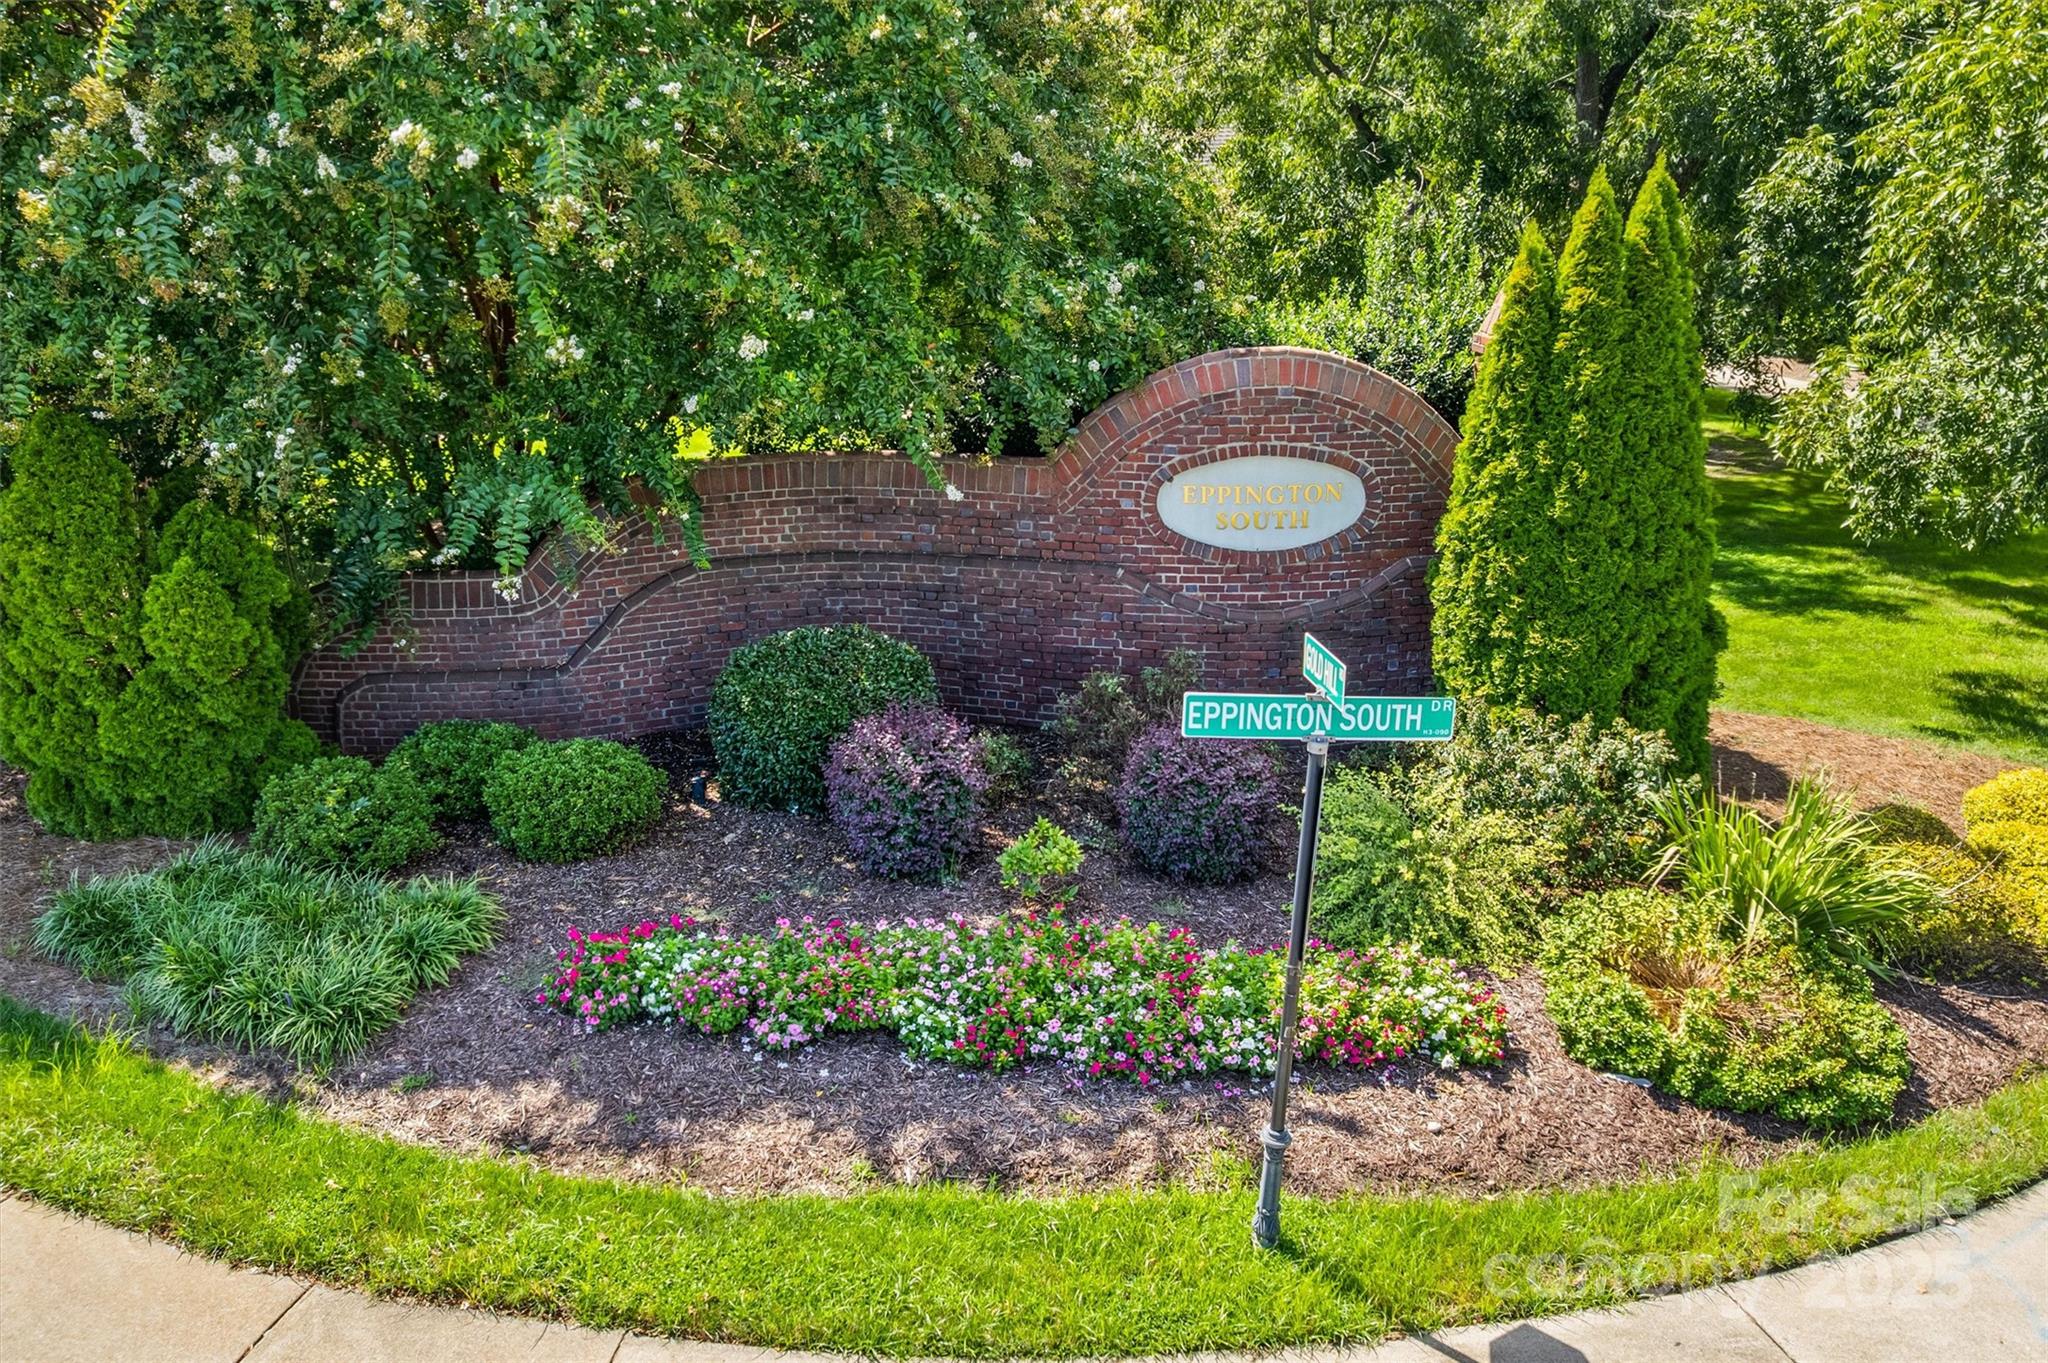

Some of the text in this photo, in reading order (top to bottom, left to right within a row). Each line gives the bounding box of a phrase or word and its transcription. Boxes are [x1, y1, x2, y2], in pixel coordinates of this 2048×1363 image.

[1182, 483, 1344, 505] EPPINGTON
[1215, 509, 1311, 530] SOUTH
[1306, 643, 1338, 697] GOLD HILL
[1188, 700, 1453, 731] EPPINGTON SOUTH DR
